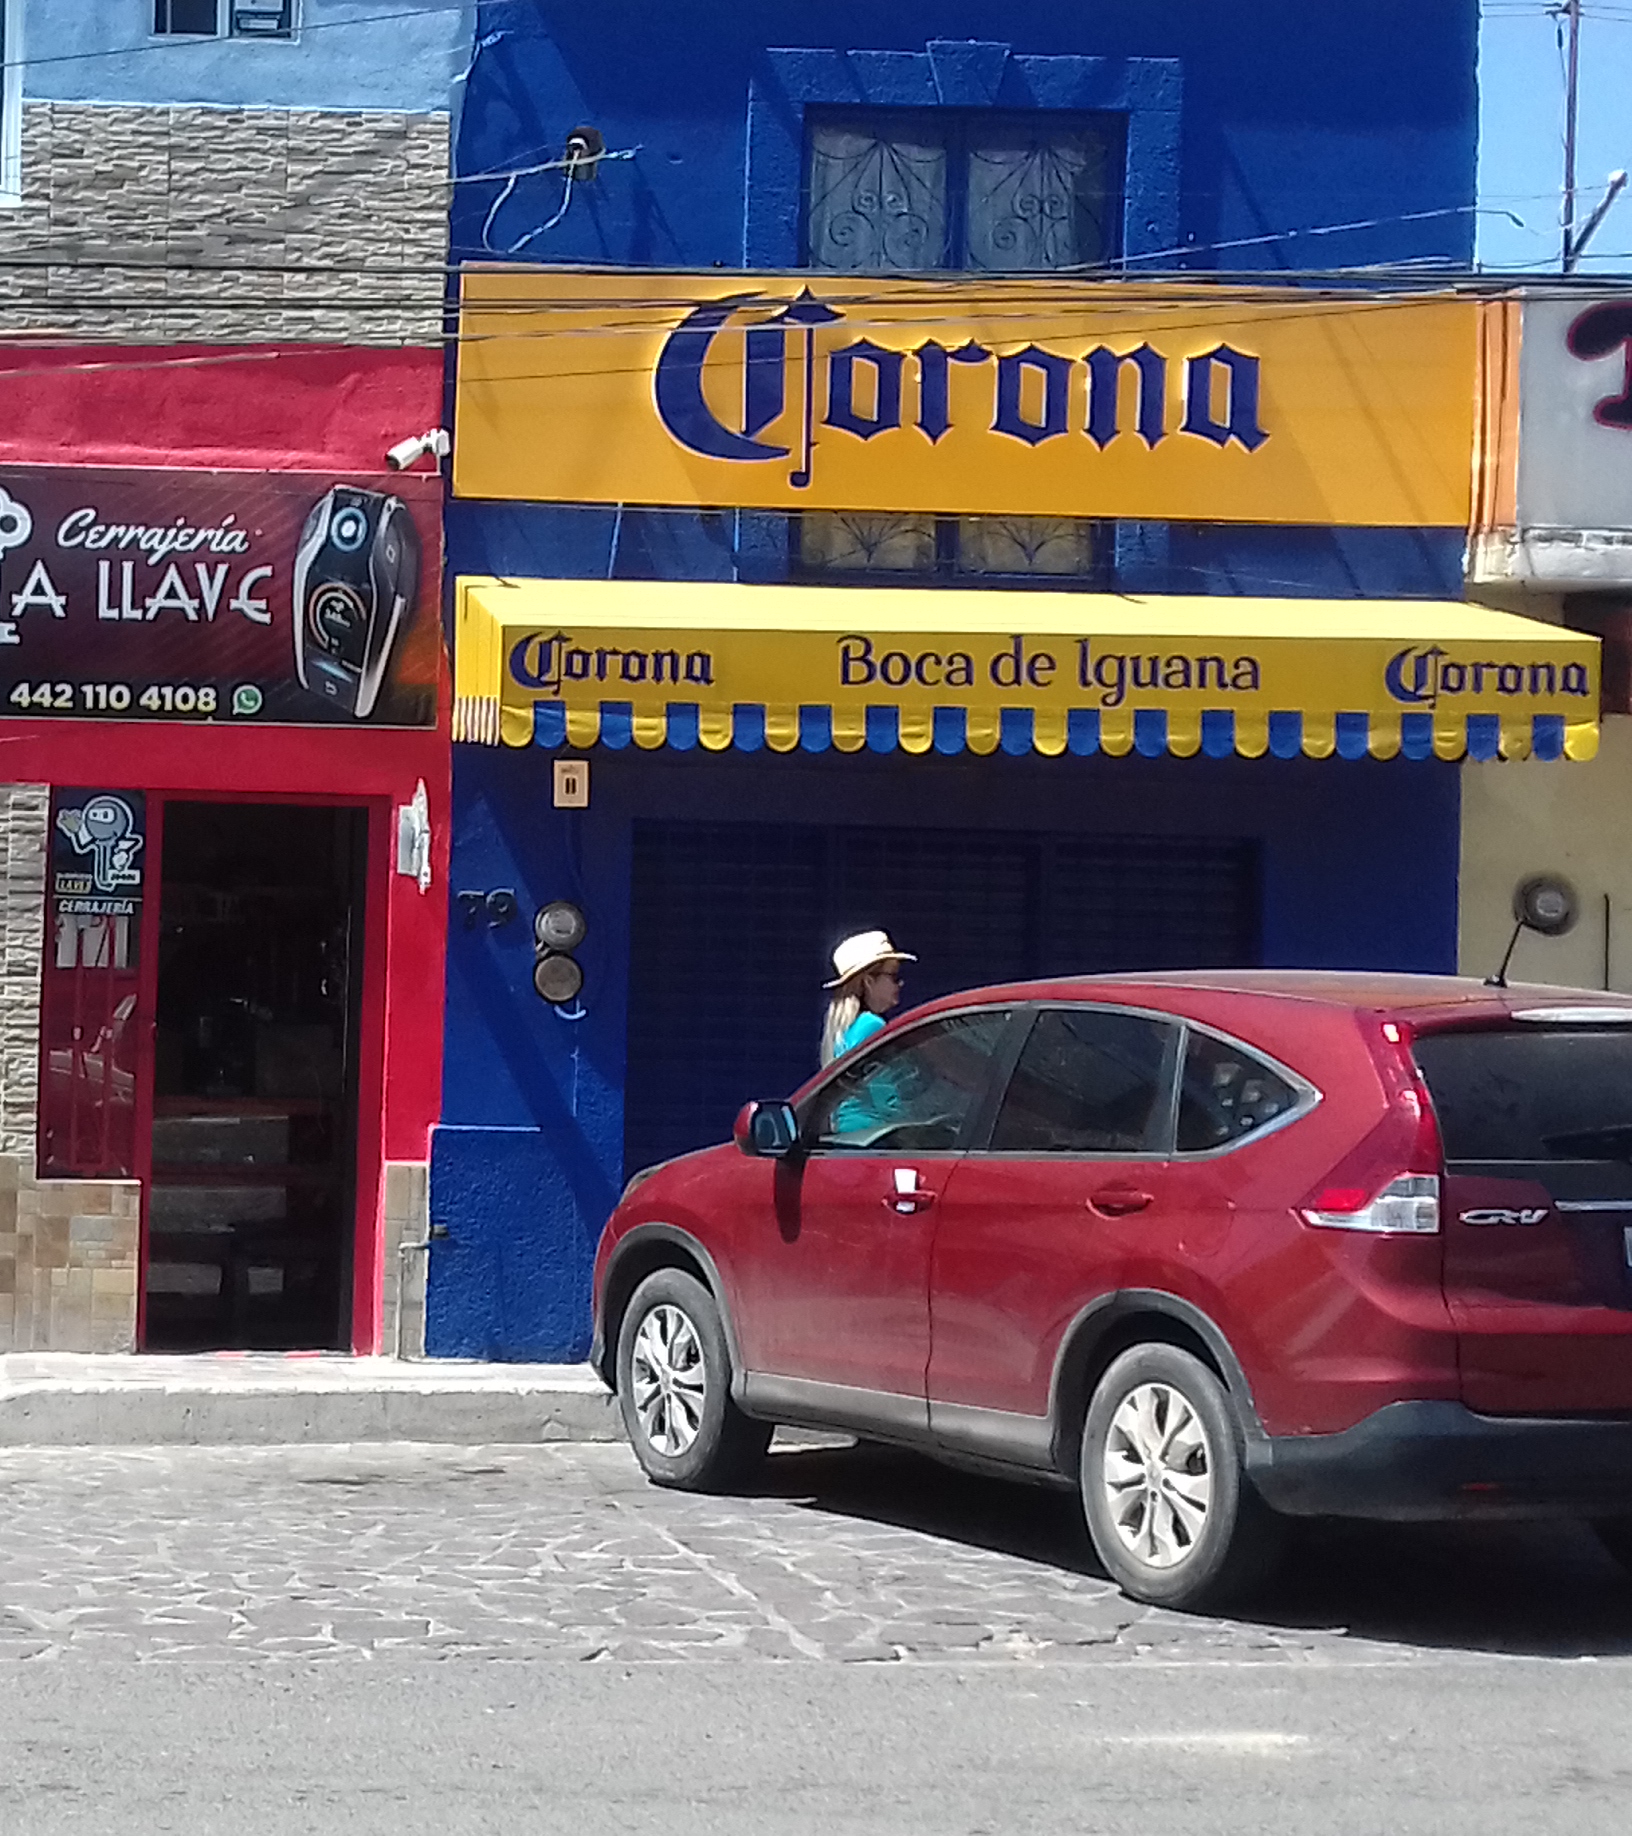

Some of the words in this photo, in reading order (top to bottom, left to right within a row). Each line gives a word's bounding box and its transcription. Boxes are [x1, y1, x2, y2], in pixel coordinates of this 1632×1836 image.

[653, 285, 1270, 488] Corona
[56, 507, 251, 566] Cerrajería
[98, 559, 274, 625] LLAVE
[9, 682, 74, 709] 442
[80, 683, 132, 710] 110
[139, 685, 218, 713] 4108
[508, 630, 716, 696] Corona
[836, 634, 975, 688] Boca
[990, 635, 1057, 689] de
[1074, 637, 1261, 706] Iguana
[1385, 644, 1592, 709] Corona
